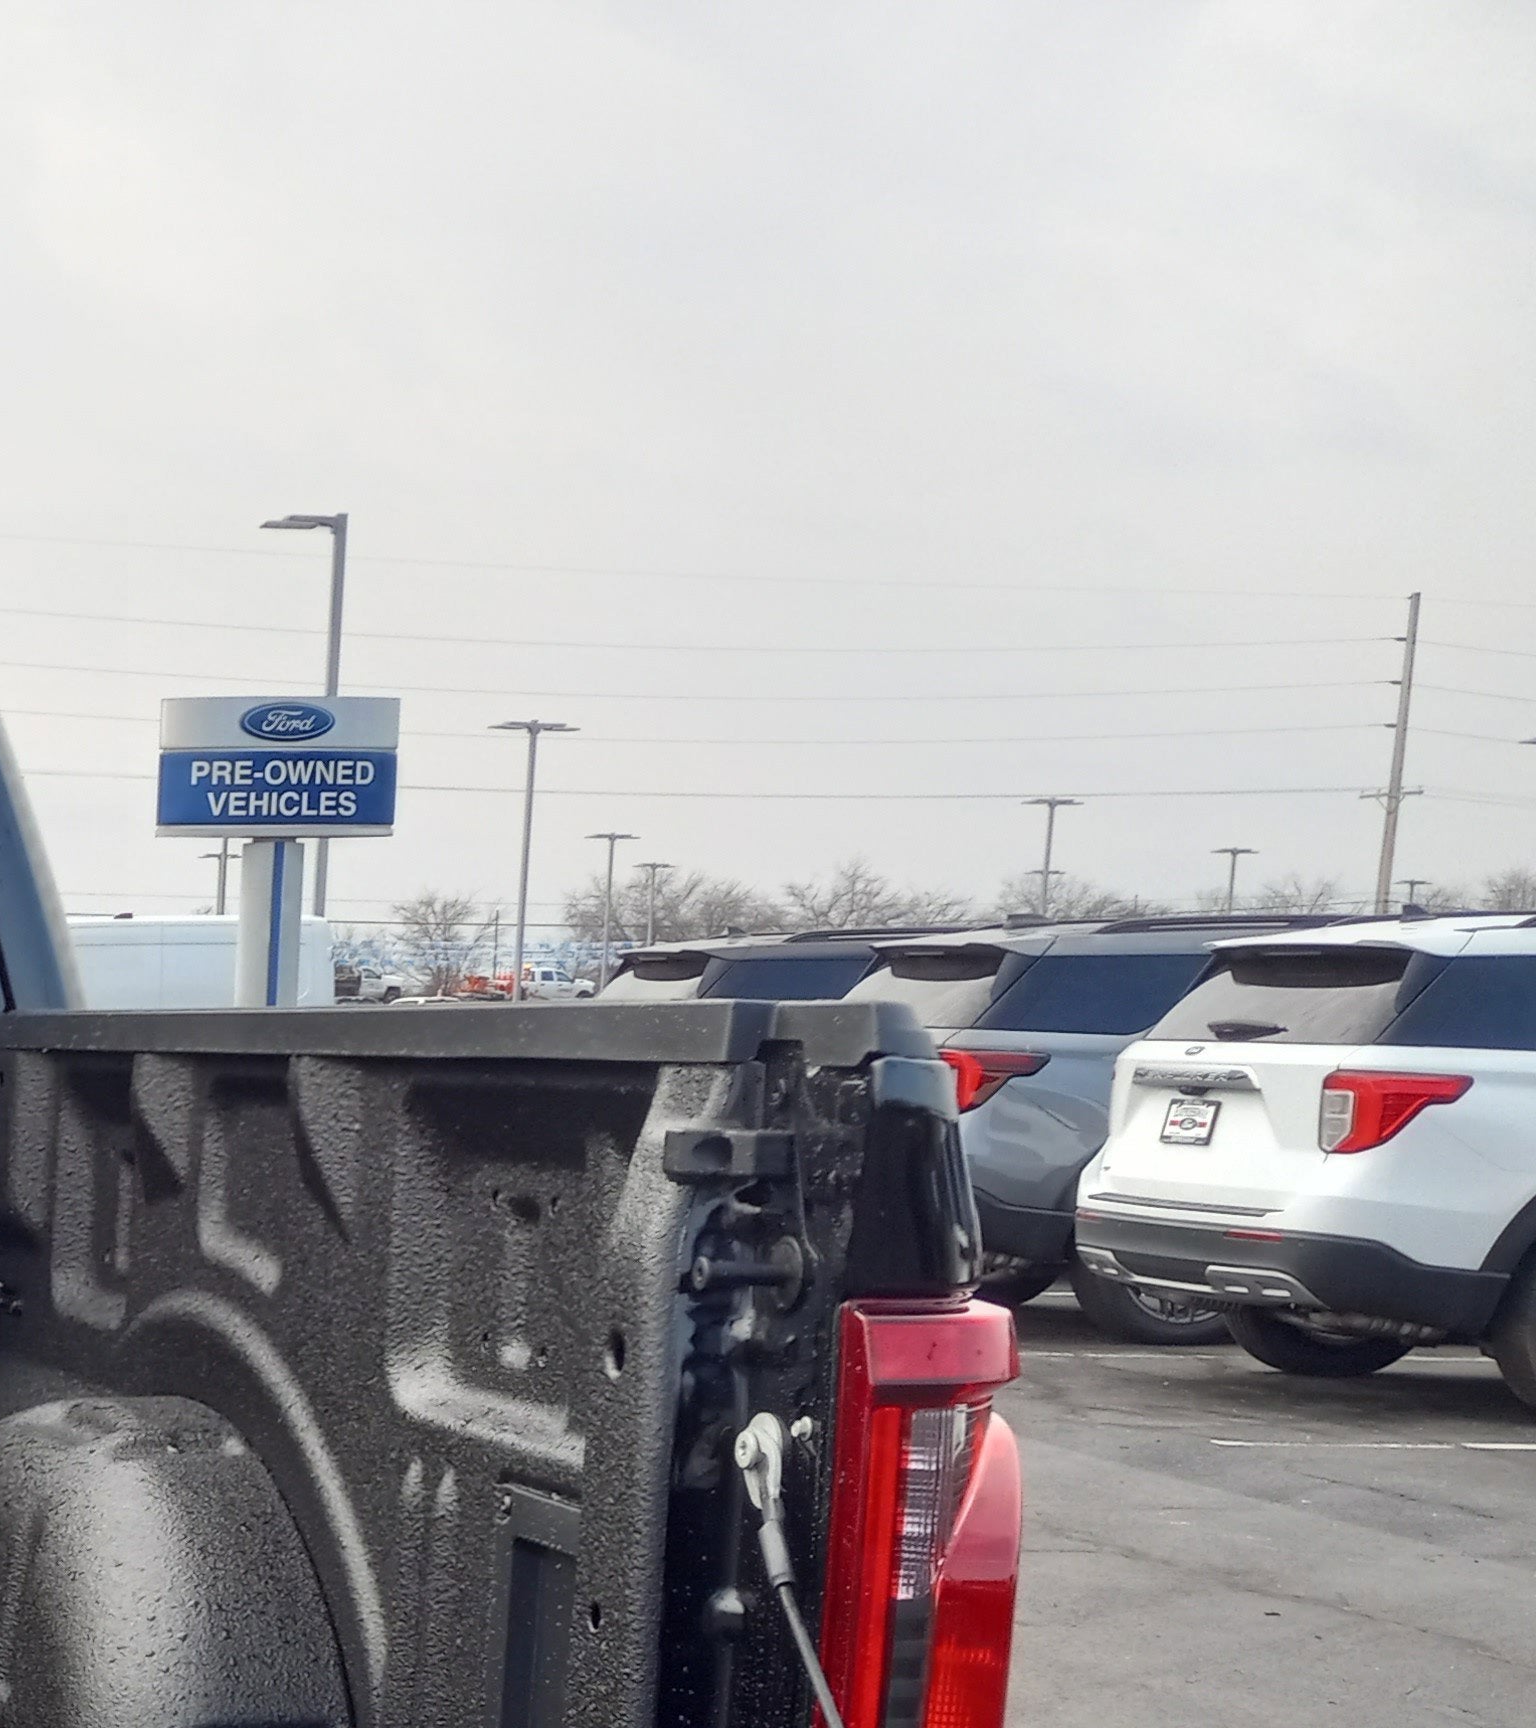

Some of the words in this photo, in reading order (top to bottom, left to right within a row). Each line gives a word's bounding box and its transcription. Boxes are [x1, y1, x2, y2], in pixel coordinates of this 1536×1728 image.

[261, 708, 318, 732] Ford
[190, 760, 375, 786] PRE-OWNED
[206, 791, 357, 817] VEHICLES
